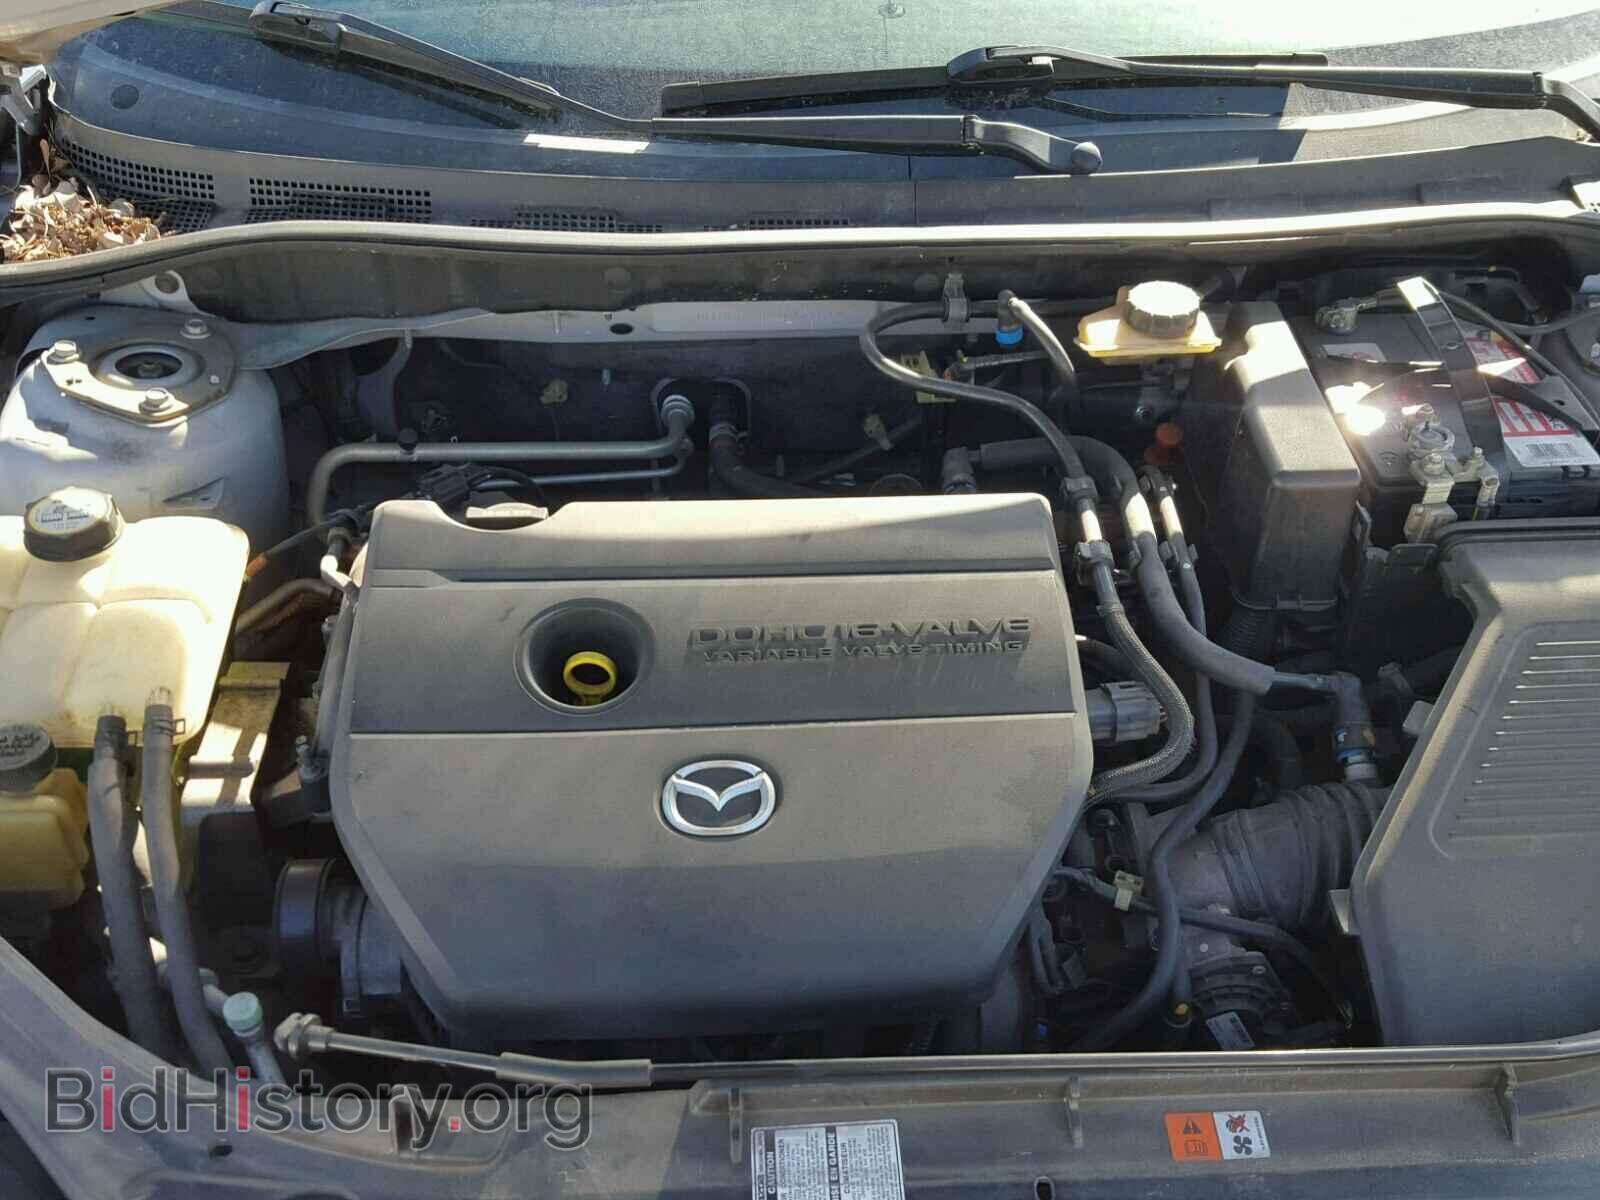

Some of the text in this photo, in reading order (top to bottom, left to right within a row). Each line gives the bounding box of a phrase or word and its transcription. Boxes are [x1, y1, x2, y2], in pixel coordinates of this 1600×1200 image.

[689, 624, 830, 646] DOHC
[703, 640, 1024, 664] VARIABLE VALVE TIMING
[766, 1152, 776, 1194] CAUTION
